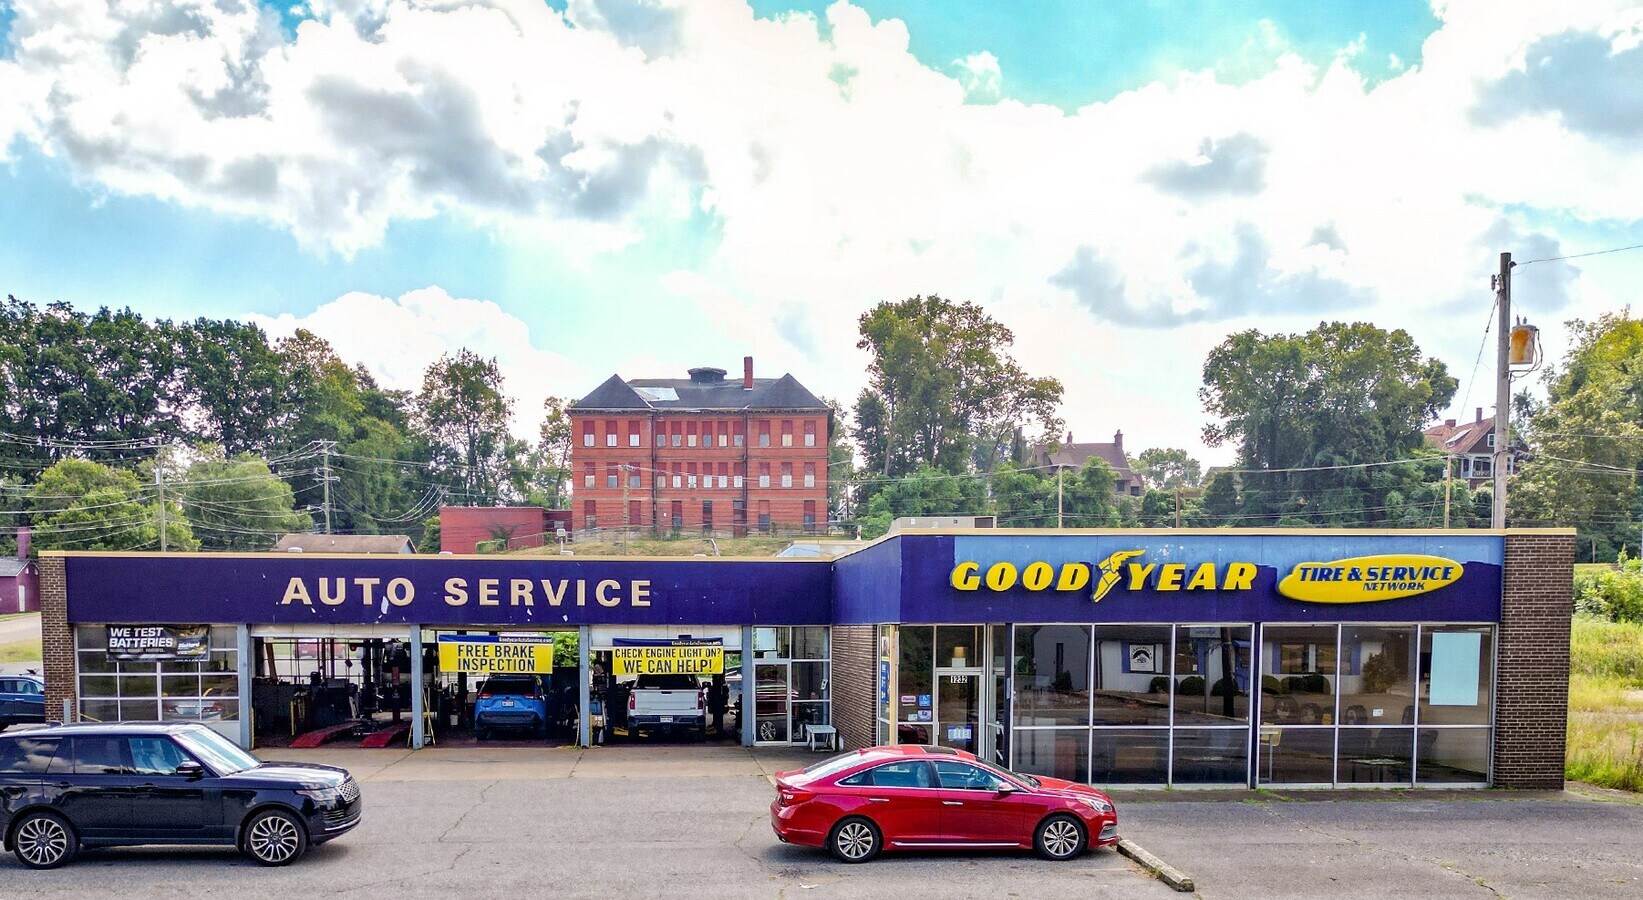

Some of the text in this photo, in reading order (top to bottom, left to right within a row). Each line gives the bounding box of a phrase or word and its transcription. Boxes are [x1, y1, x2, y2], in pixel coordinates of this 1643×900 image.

[1300, 566, 1454, 581] TIRE & SERVICE
[281, 577, 651, 607] AUTO SERVICE
[1363, 582, 1425, 591] NETWORK
[110, 627, 163, 637] WE TEST
[109, 637, 174, 648] BATTERIES
[458, 645, 535, 658] FREE BRAKE
[615, 648, 721, 658] CHECK ENGINE LIGHT ON?
[458, 658, 535, 671] INSPECTION
[623, 659, 712, 673] WE CAN HELP!
